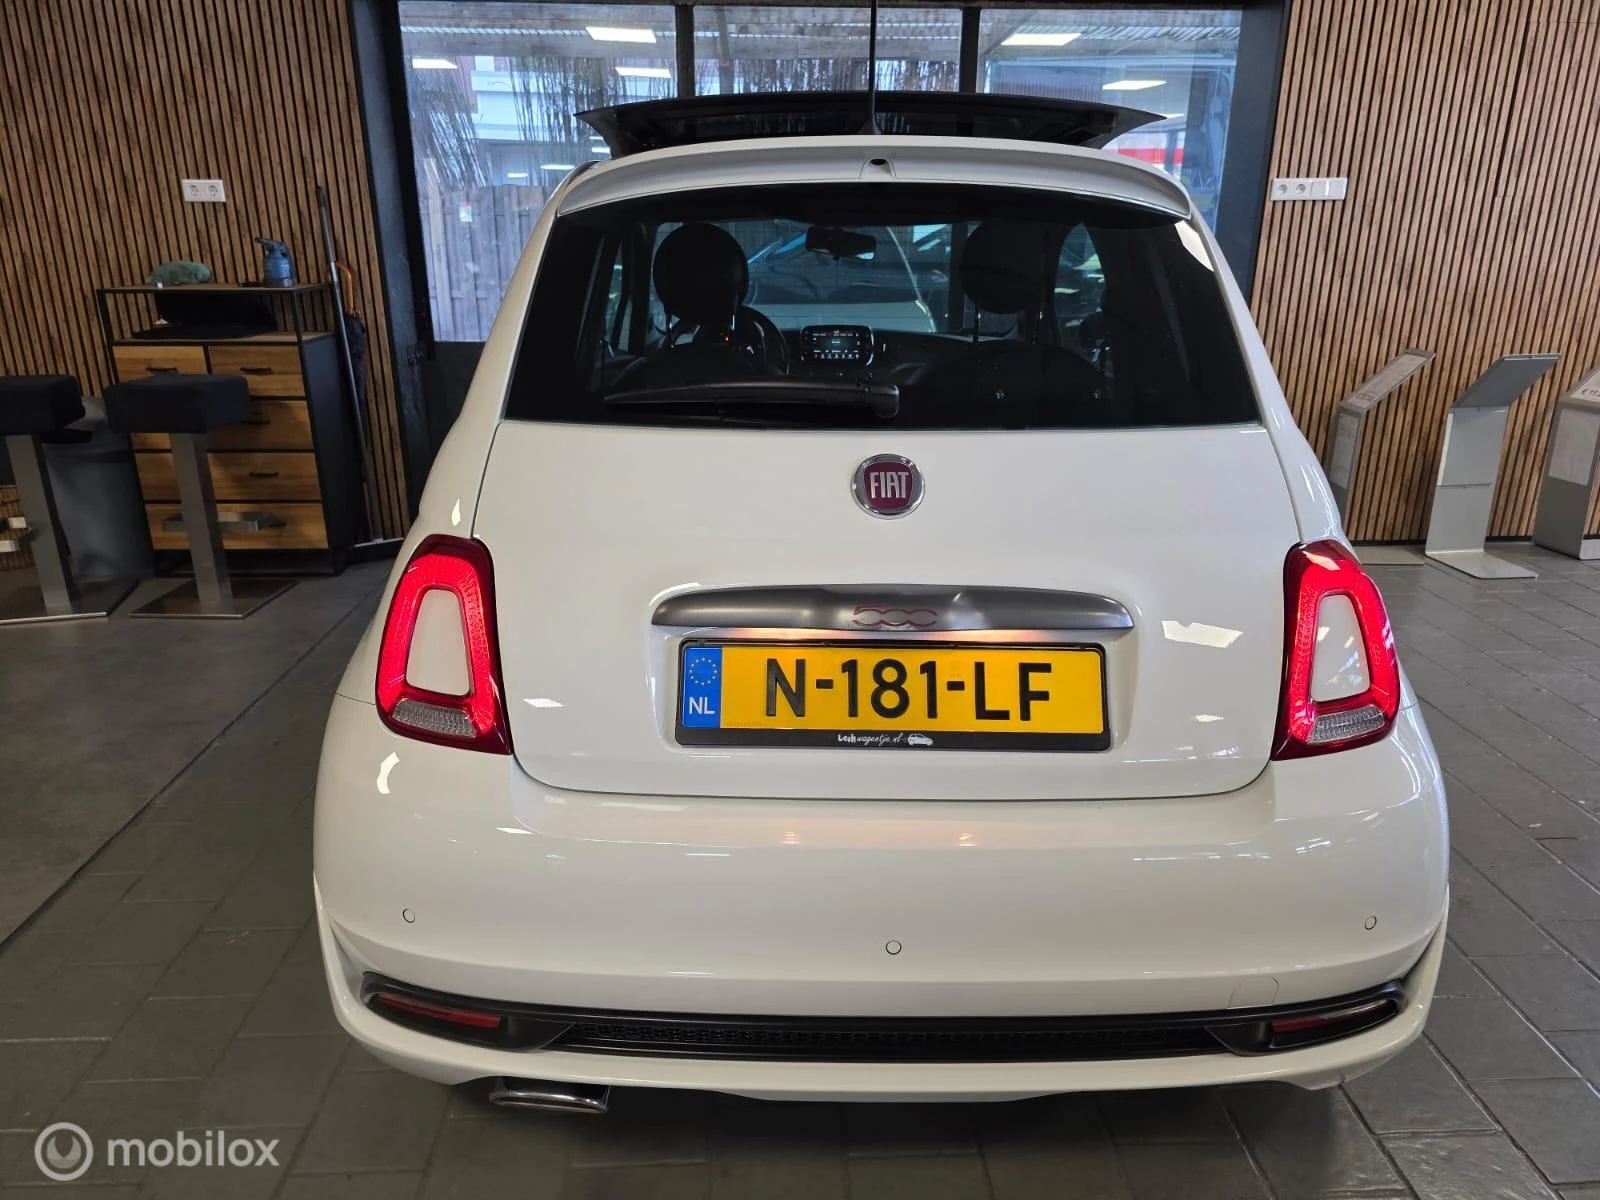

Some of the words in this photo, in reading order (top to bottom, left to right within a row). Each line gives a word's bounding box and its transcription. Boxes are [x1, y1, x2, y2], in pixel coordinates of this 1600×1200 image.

[869, 471, 909, 499] FIAT
[853, 604, 938, 627] 500
[765, 658, 1052, 722] N-181-LF
[688, 696, 716, 715] NL
